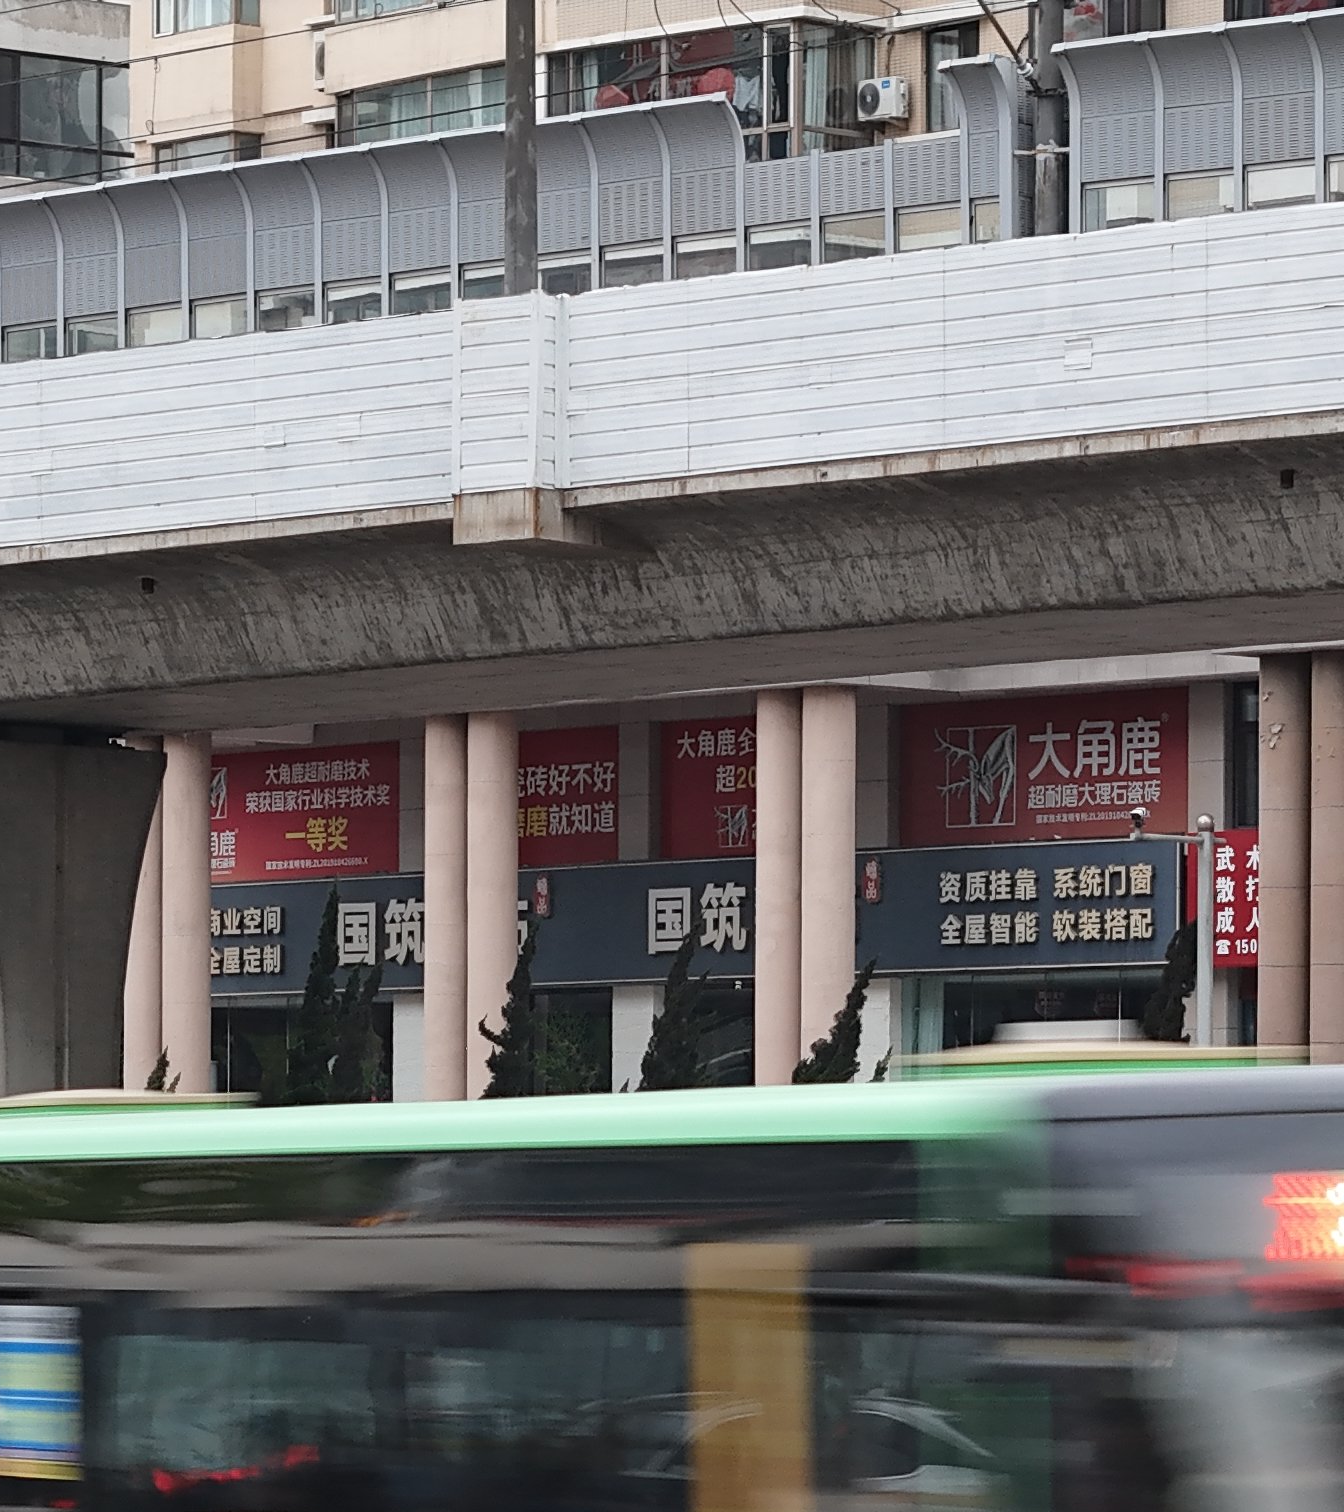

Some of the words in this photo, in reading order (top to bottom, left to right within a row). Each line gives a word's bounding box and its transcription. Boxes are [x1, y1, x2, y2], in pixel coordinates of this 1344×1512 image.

[1027, 717, 1161, 780] 大角鹿
[265, 759, 370, 786] 大角鹿超耐磨技术
[245, 784, 390, 814] 荣获国家行业科学技术奖
[1027, 780, 1161, 810] 超耐磨大理石瓷砖
[285, 816, 348, 853] 一等奖
[939, 868, 1038, 904] 资质挂靠
[1053, 863, 1153, 898] 系统门窗
[337, 897, 425, 966] 国筑
[648, 882, 747, 955] 国筑
[940, 911, 1038, 946] 全屋智能
[1052, 908, 1153, 942] 软装搭配
